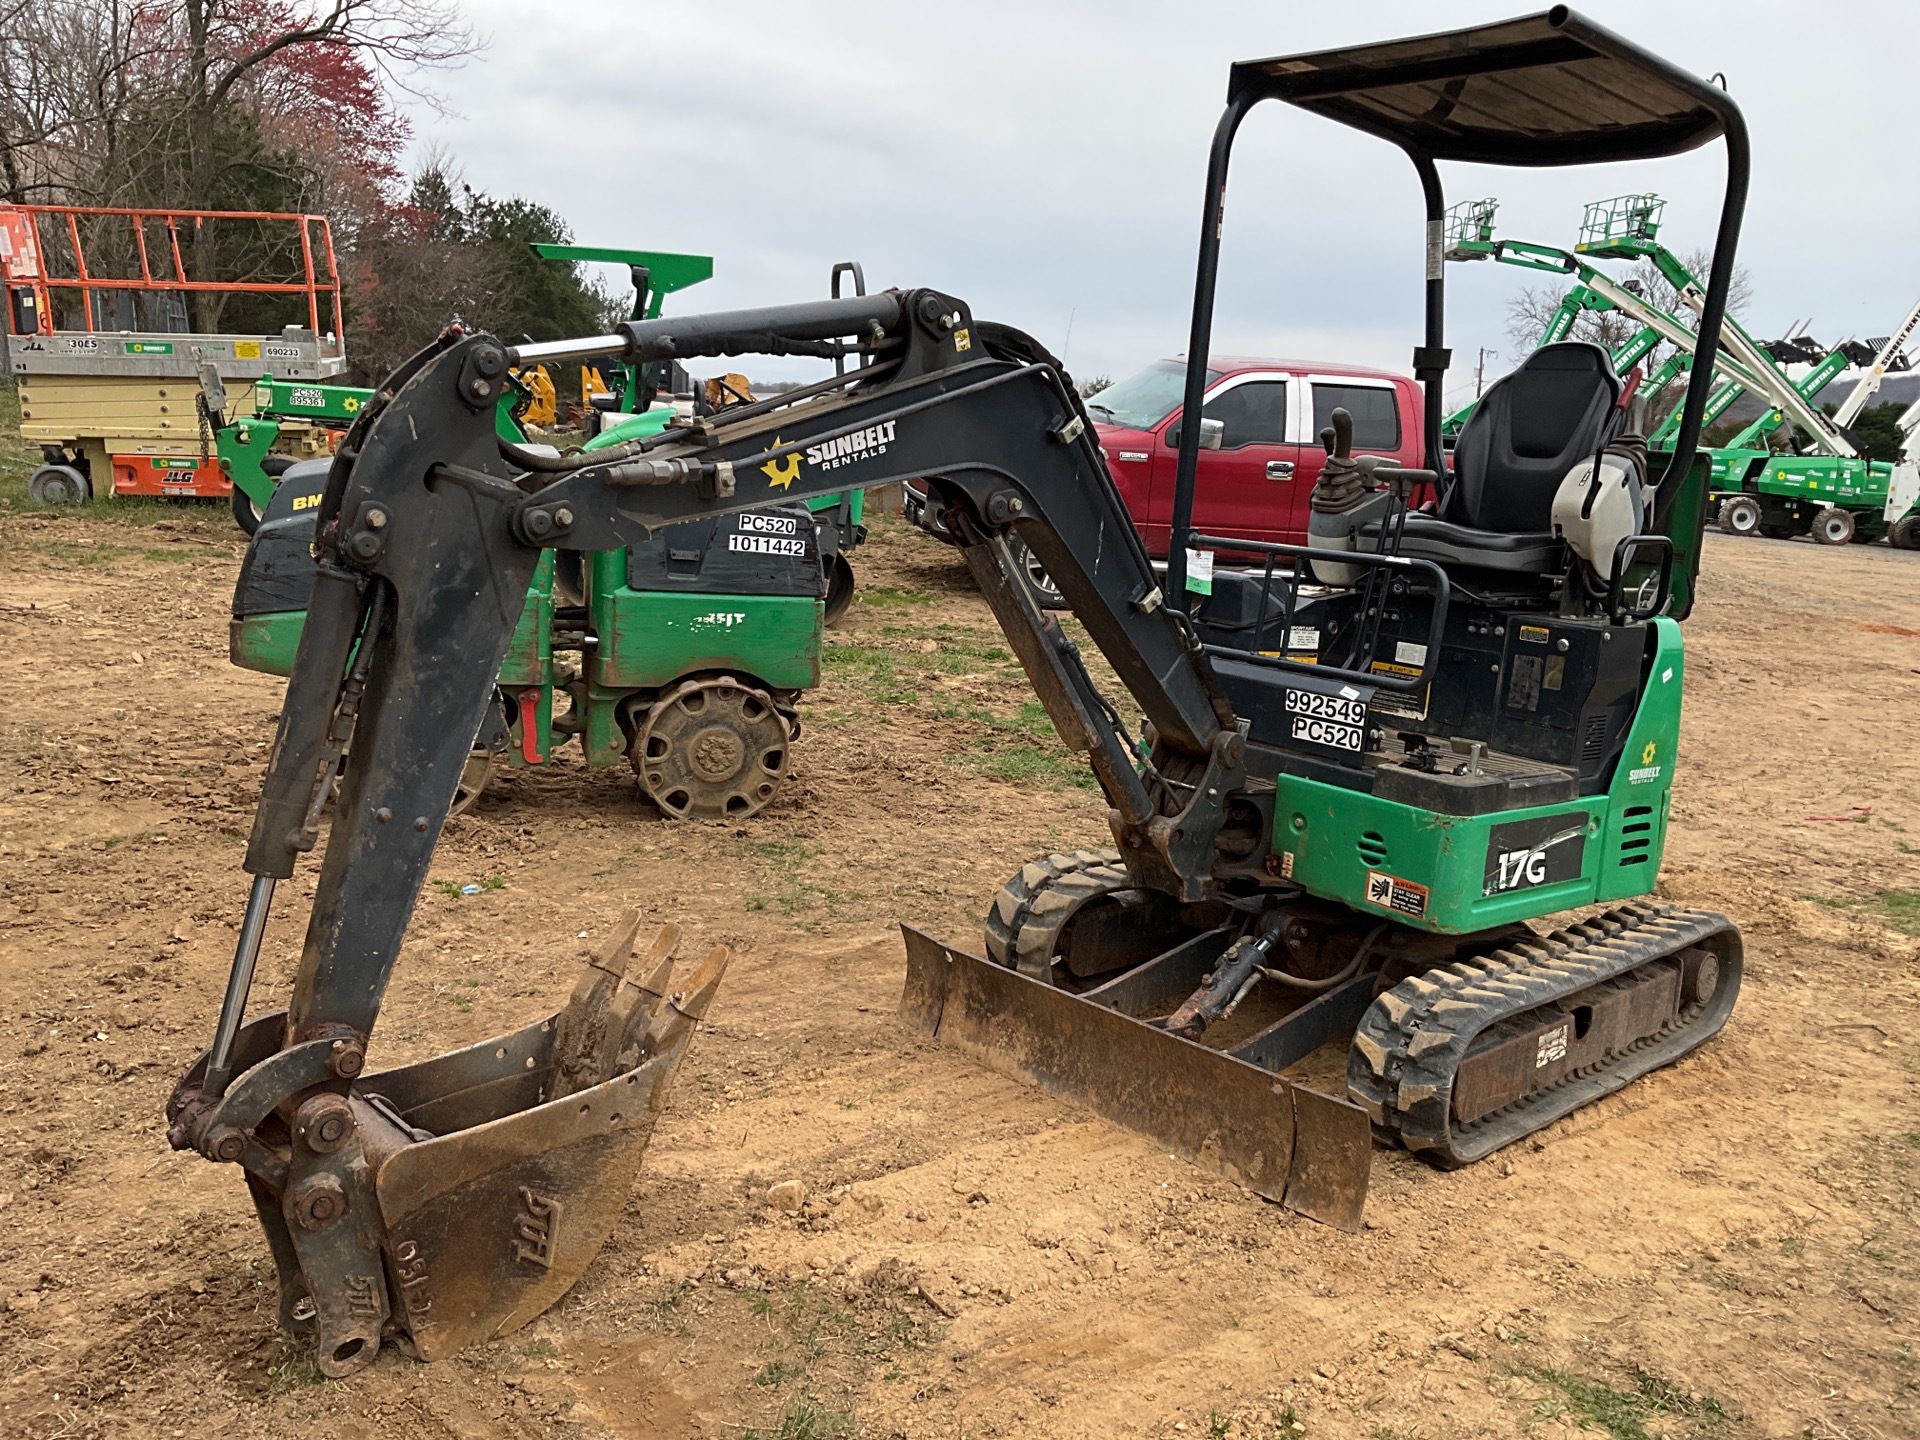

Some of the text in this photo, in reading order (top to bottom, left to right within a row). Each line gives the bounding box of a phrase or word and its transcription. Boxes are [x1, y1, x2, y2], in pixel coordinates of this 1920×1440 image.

[267, 347, 299, 356] 690233
[290, 397, 325, 406] 895361
[292, 388, 322, 398] PC520
[806, 420, 896, 465] SUNBELT
[822, 444, 887, 471] RENTALS
[162, 471, 193, 483] JLG
[740, 515, 795, 534] PC520
[731, 536, 804, 555] 1011442
[1286, 691, 1364, 724] 992549
[1294, 718, 1361, 749] PC520
[1498, 849, 1546, 890] 17G
